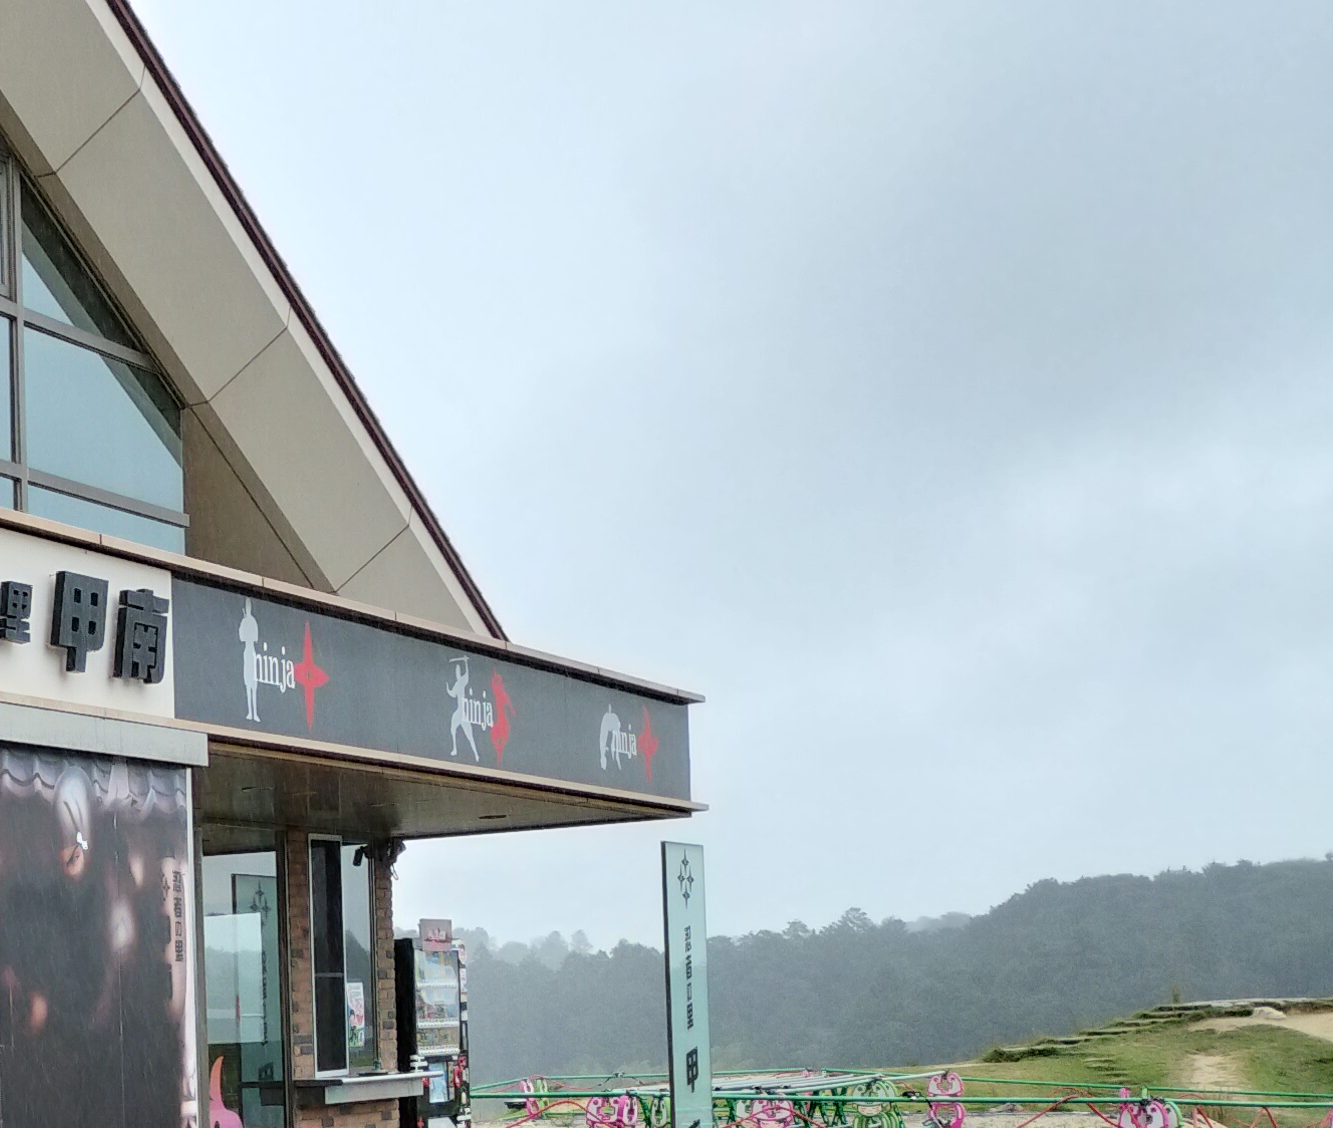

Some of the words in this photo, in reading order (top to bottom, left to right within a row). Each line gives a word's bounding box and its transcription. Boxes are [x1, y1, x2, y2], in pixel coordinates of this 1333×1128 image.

[49, 570, 170, 684] 甲南
[253, 641, 296, 694] ninja
[461, 688, 495, 732] ninja
[611, 713, 638, 759] ninja
